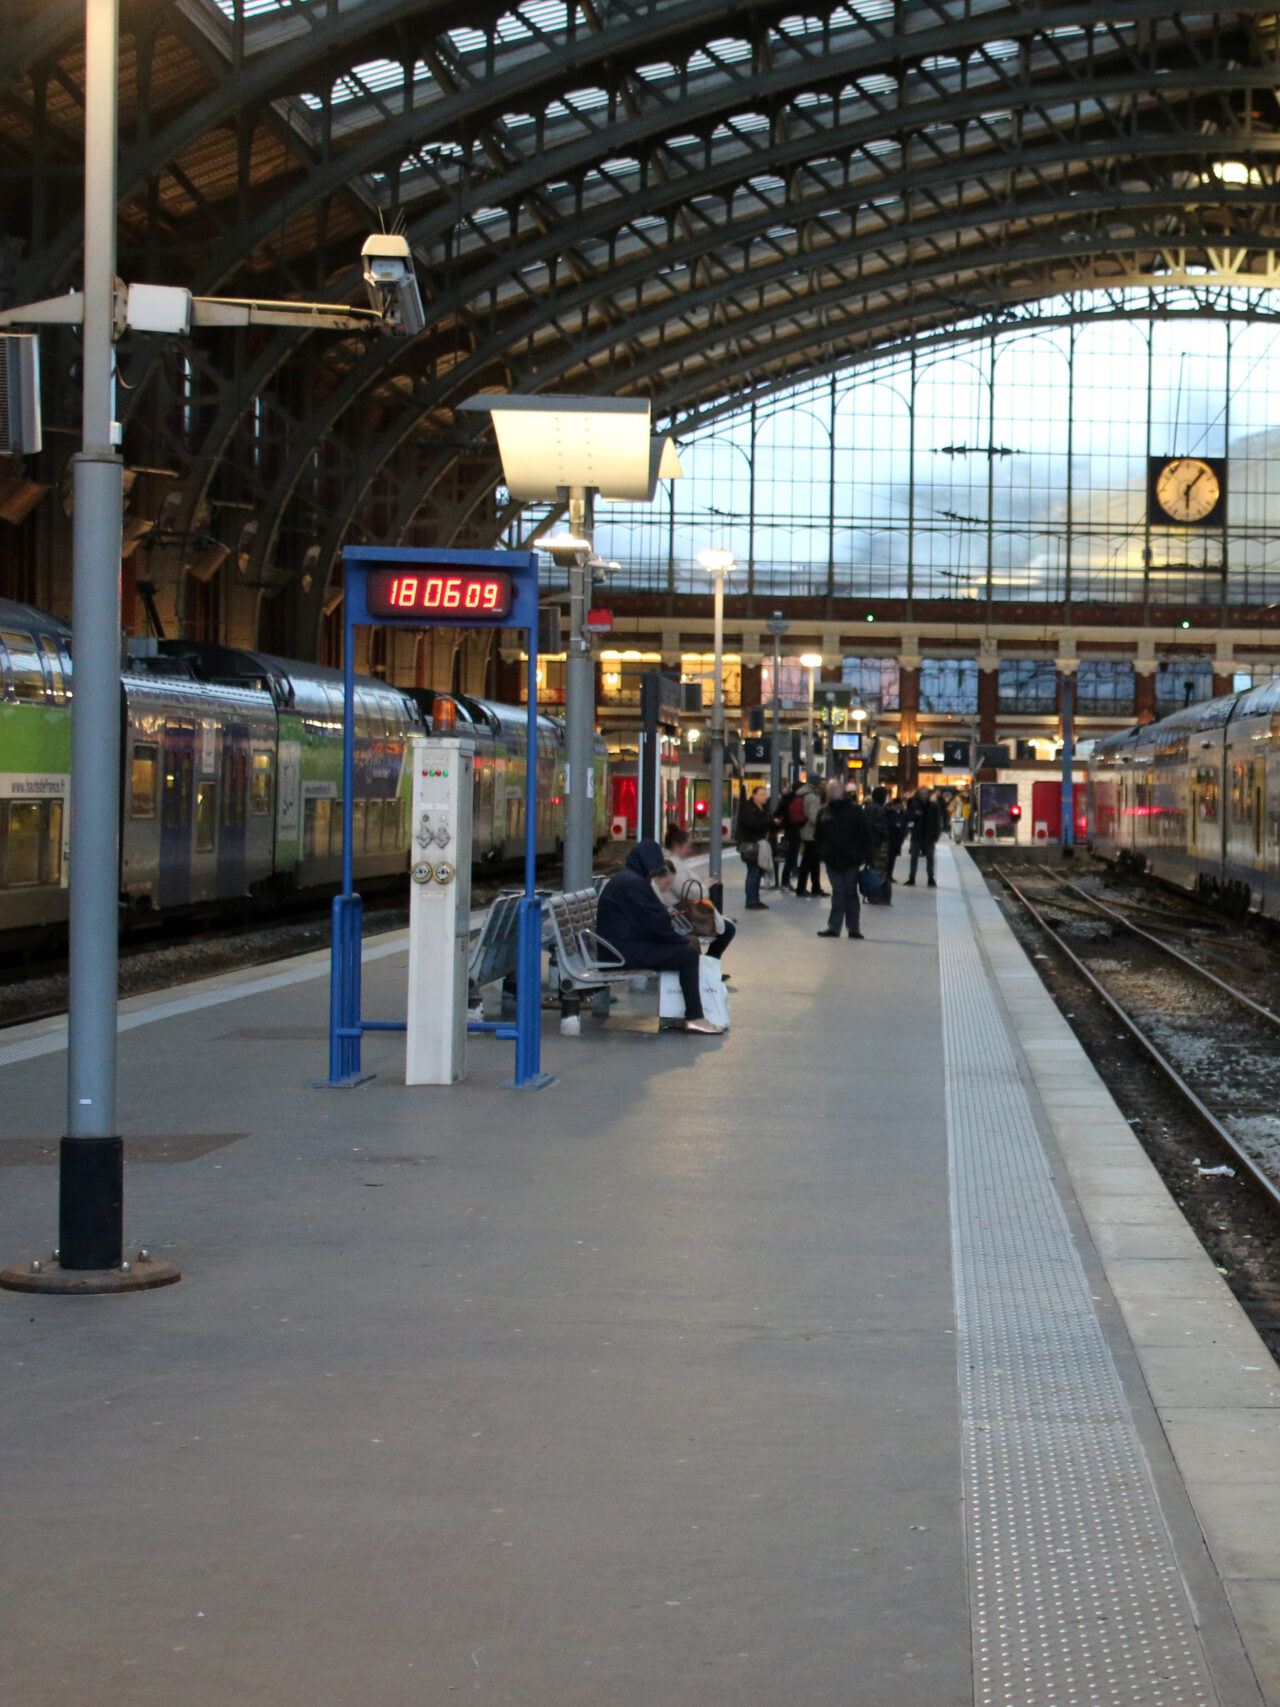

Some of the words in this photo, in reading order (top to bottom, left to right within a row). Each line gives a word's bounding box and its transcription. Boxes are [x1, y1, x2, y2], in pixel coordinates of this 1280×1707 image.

[390, 578, 418, 607] 18
[423, 578, 461, 607] 06
[464, 583, 498, 608] 09
[755, 745, 764, 758] 3
[953, 749, 962, 760] 4
